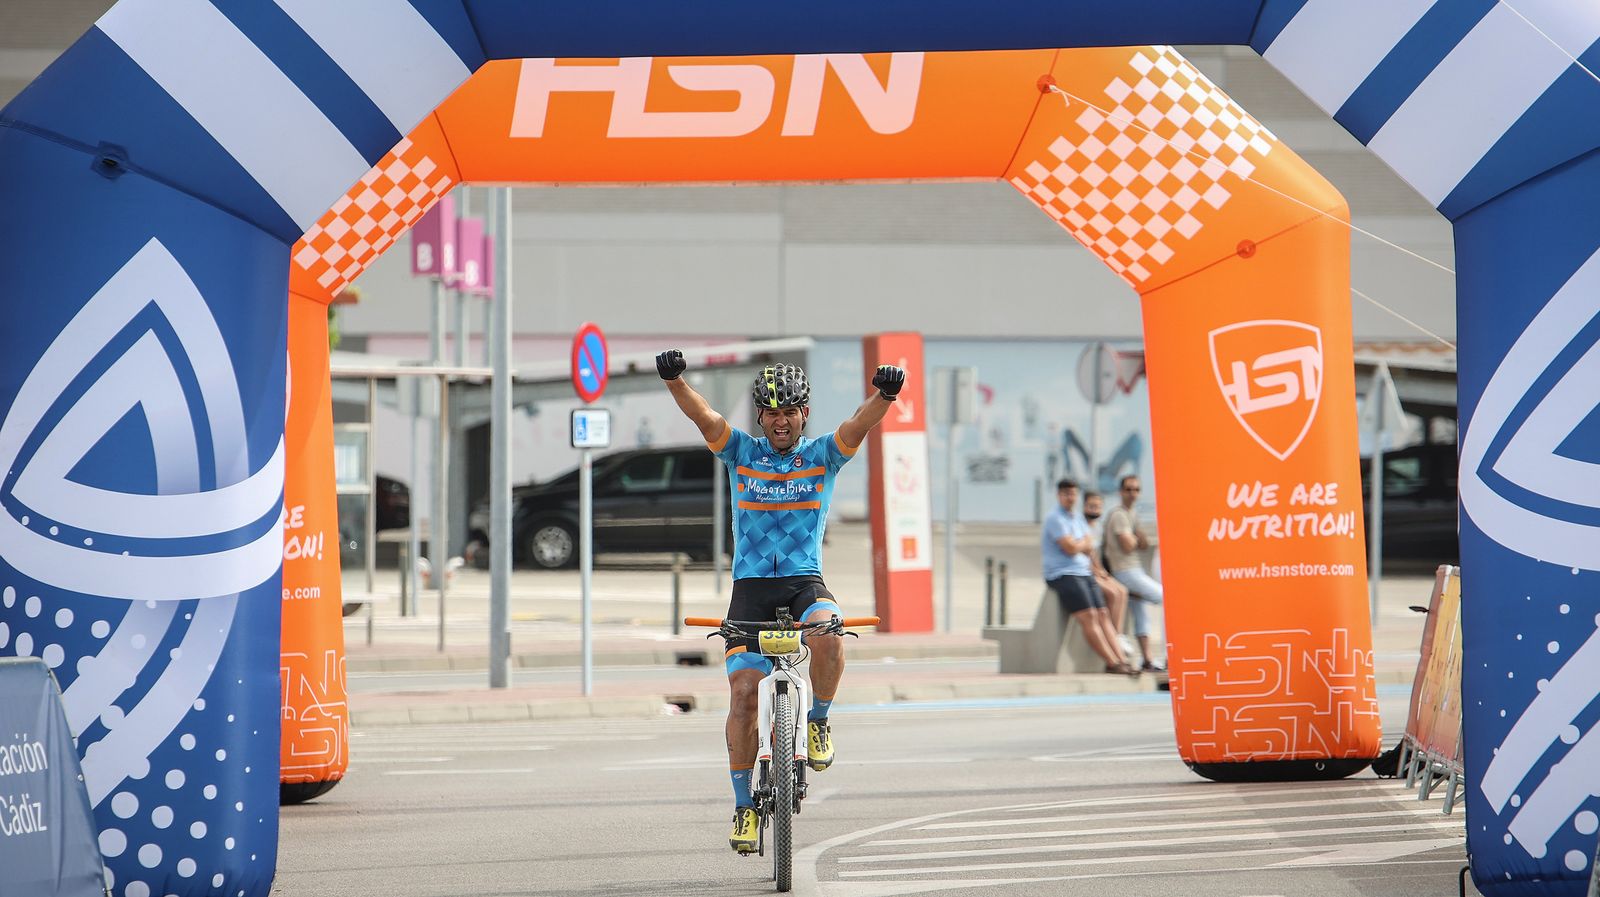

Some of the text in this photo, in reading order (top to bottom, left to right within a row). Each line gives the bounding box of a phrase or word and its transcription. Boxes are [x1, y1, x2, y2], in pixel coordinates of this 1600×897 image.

[509, 52, 925, 138] HSN
[1227, 480, 1339, 509] WE ARE
[1208, 511, 1355, 541] NUTRITION!
[1219, 563, 1354, 580] www.hsnstore.com
